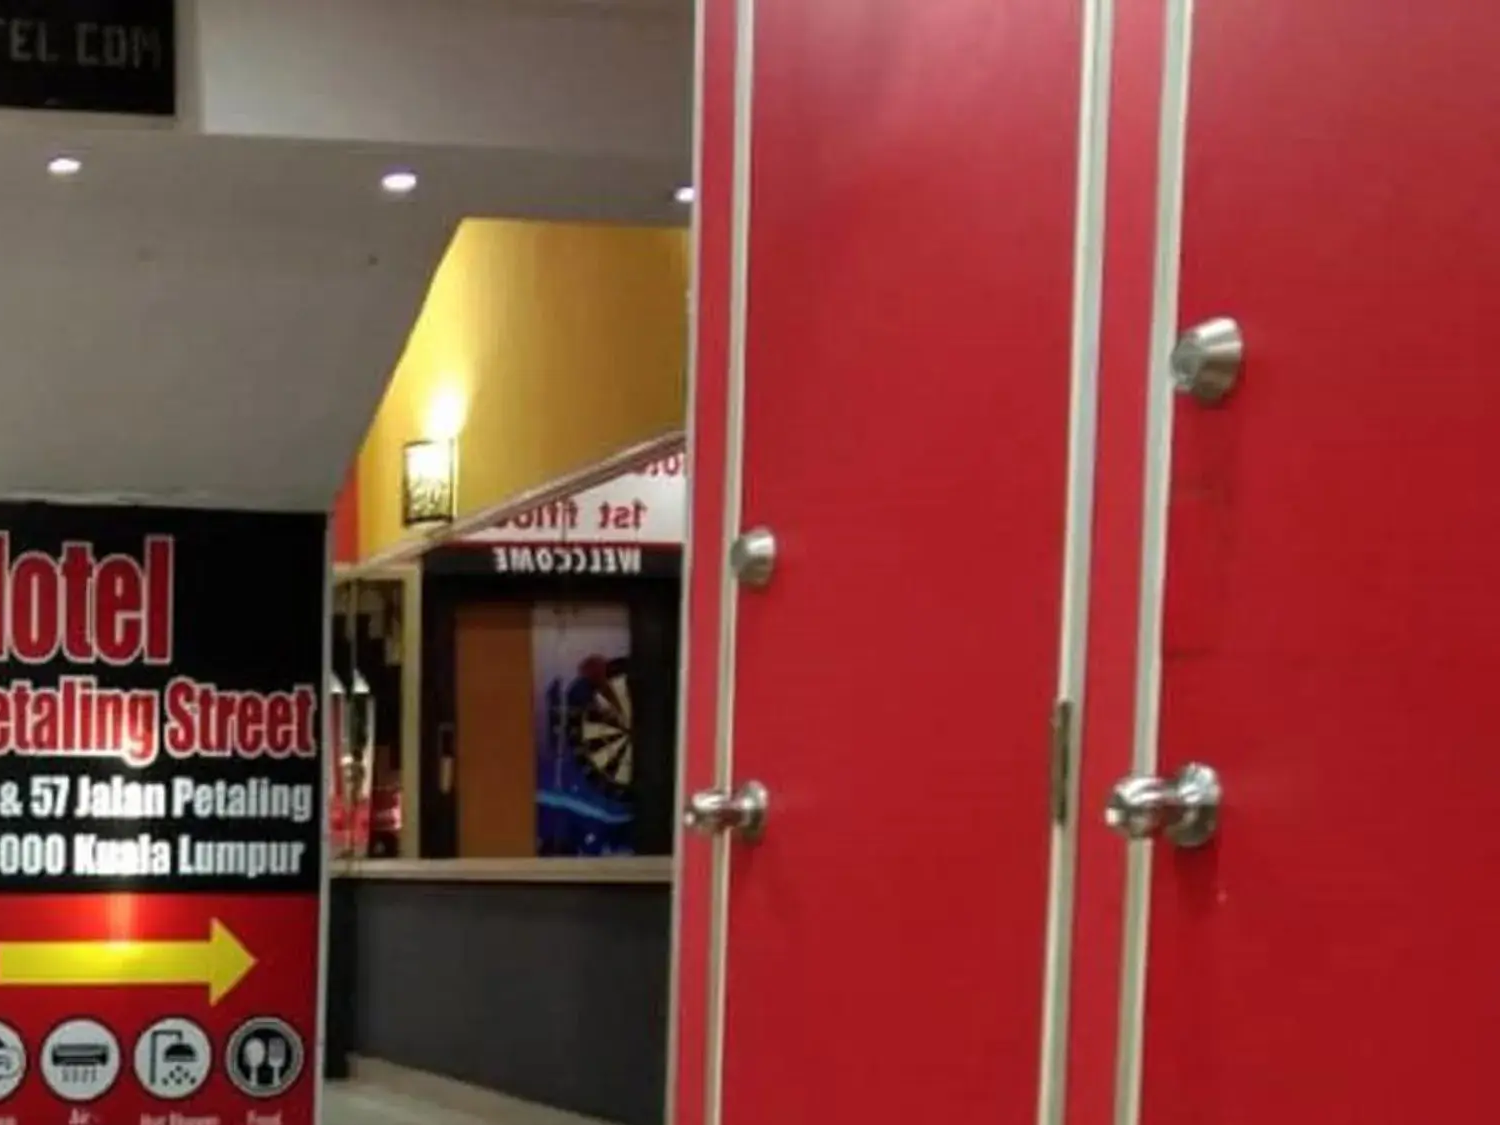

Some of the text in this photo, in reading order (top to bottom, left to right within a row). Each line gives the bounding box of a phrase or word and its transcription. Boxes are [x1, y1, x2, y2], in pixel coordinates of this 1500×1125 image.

[164, 676, 318, 760] Street
[30, 774, 70, 819] 57
[74, 775, 167, 819] Jalan
[171, 777, 312, 823] Petaling
[73, 833, 172, 878] Kuala
[177, 834, 306, 878] Lumpur
